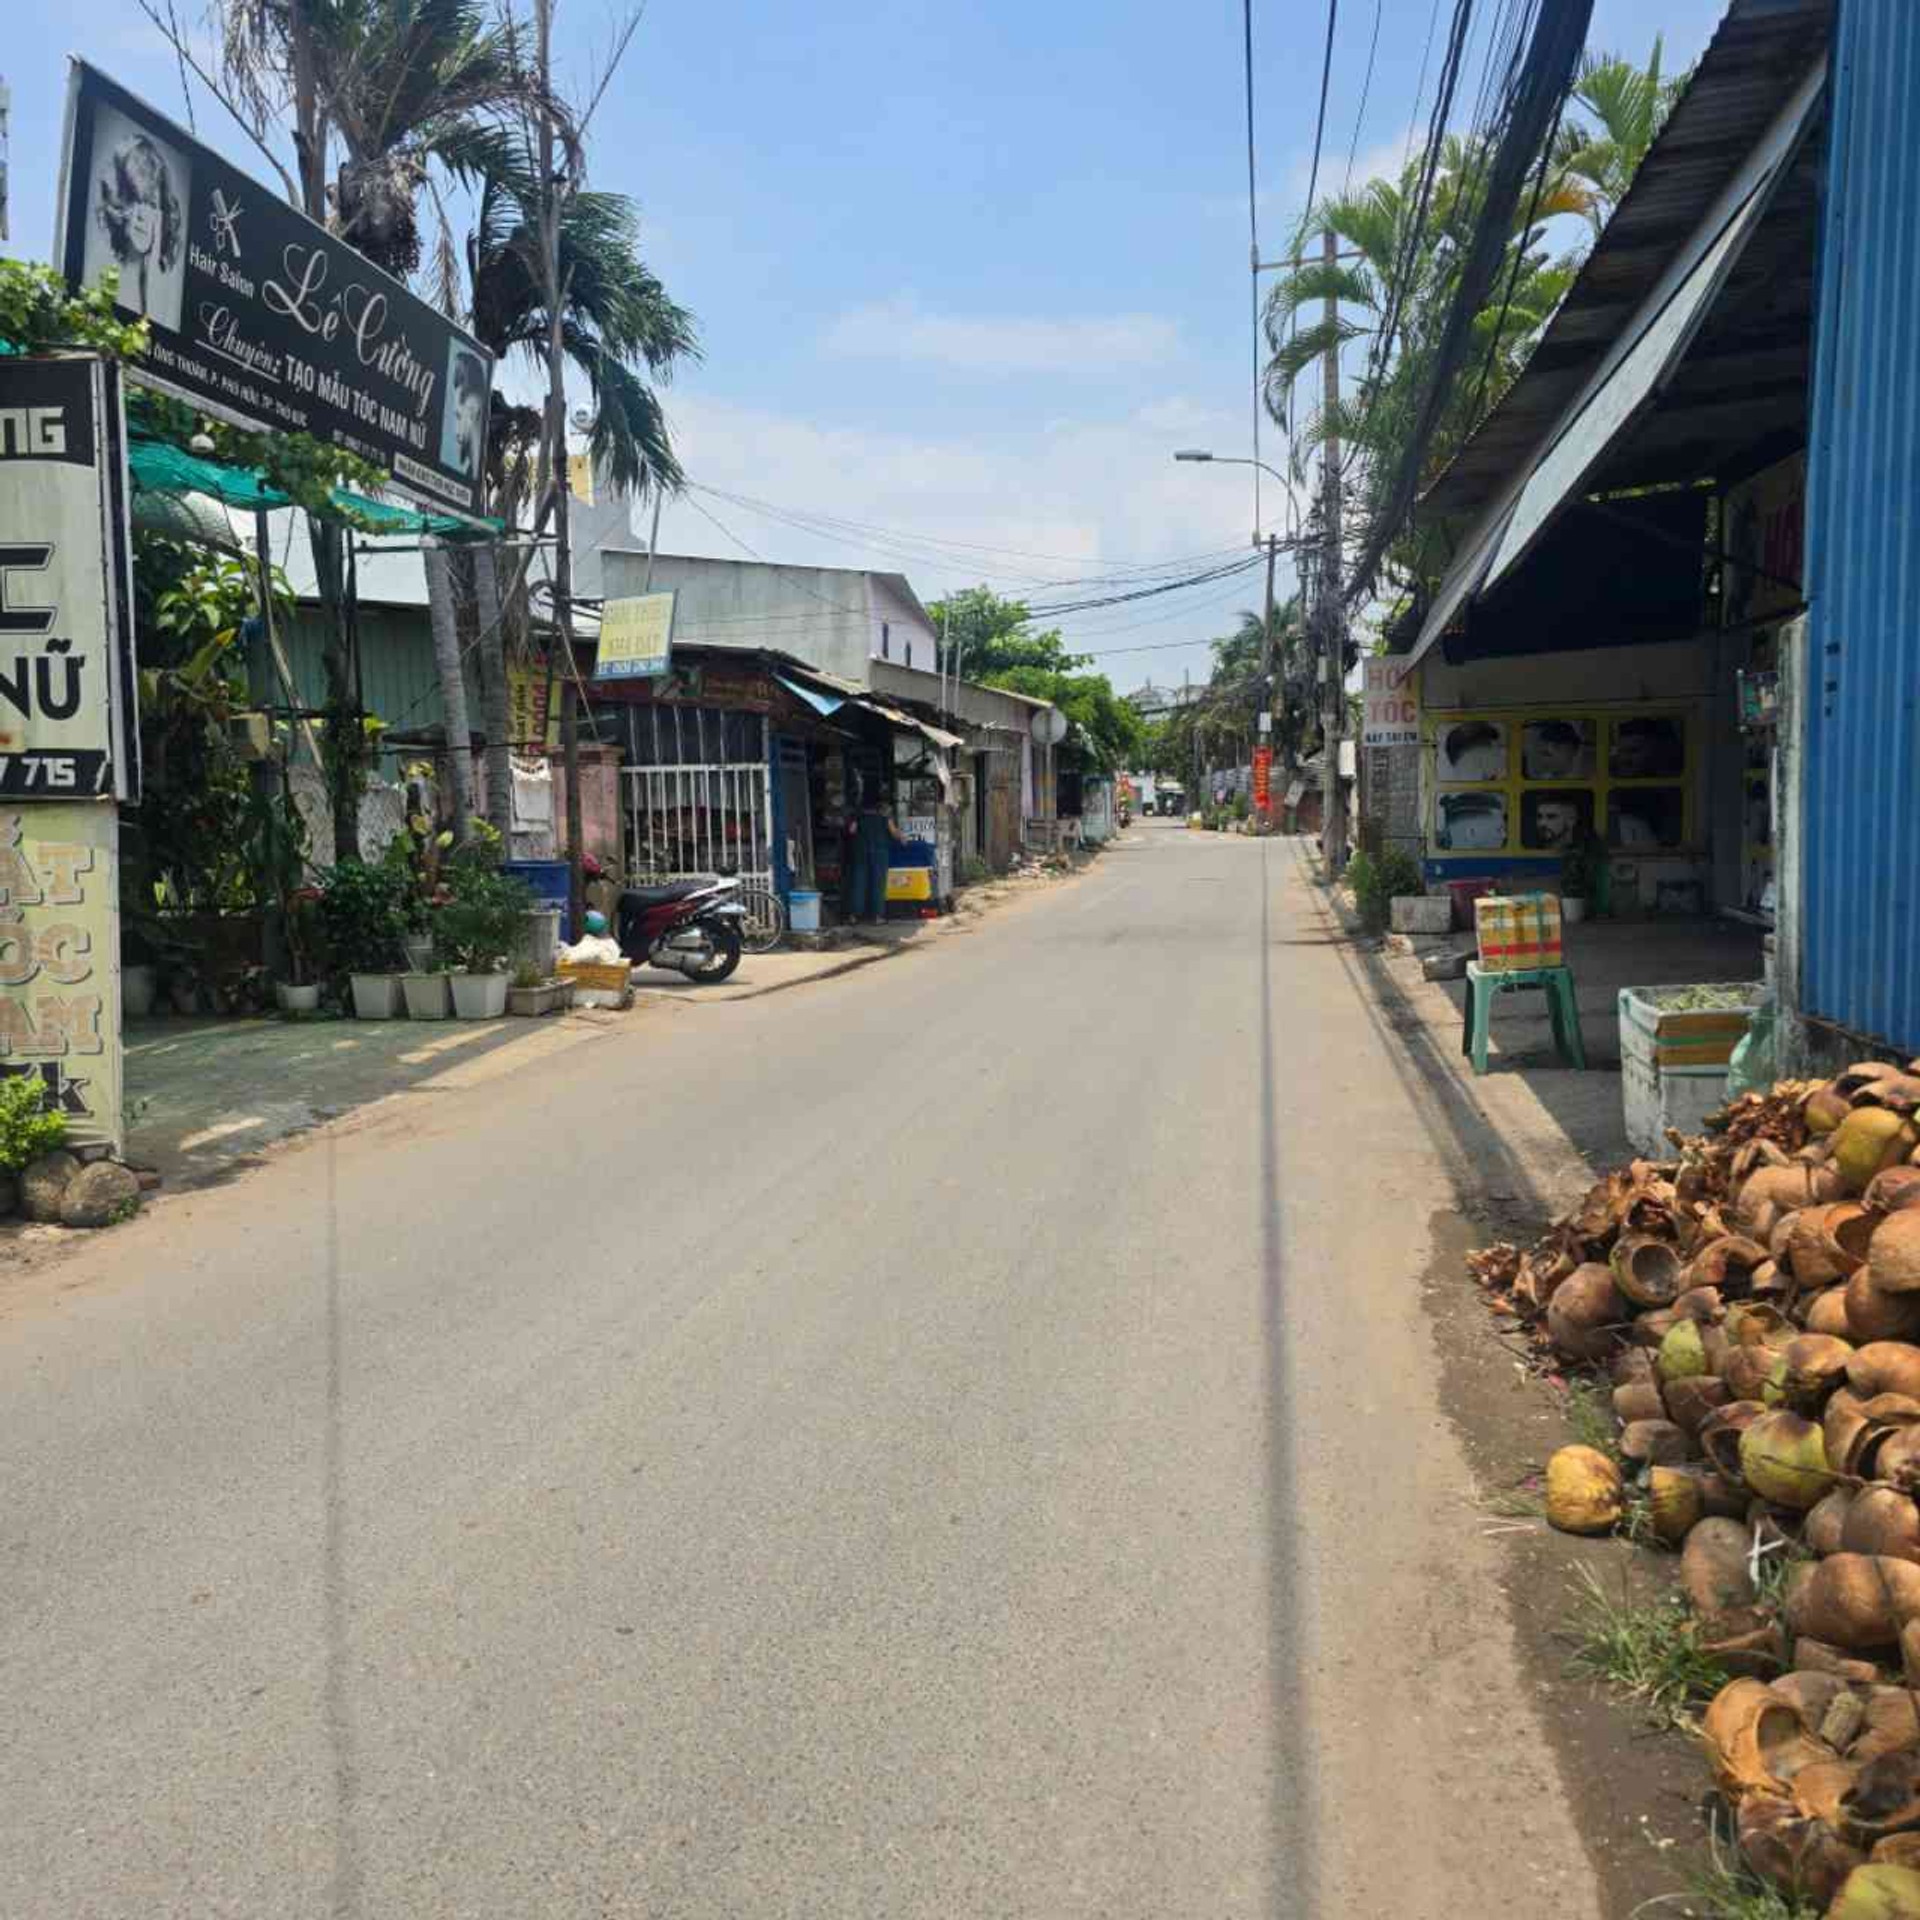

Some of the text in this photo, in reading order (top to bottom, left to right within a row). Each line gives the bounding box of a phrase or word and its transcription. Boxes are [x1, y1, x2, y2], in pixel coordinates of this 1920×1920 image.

[190, 241, 254, 300] Hair Salon
[262, 244, 435, 417] Lê Cường
[200, 301, 282, 374] Chuyên:
[285, 354, 314, 392] TẠO
[318, 370, 349, 409] MẪU
[352, 389, 377, 424] TÓC
[380, 405, 407, 439] NAM
[0, 637, 87, 721] NỮ
[1368, 694, 1416, 723] TÓC
[20, 757, 77, 788] 715
